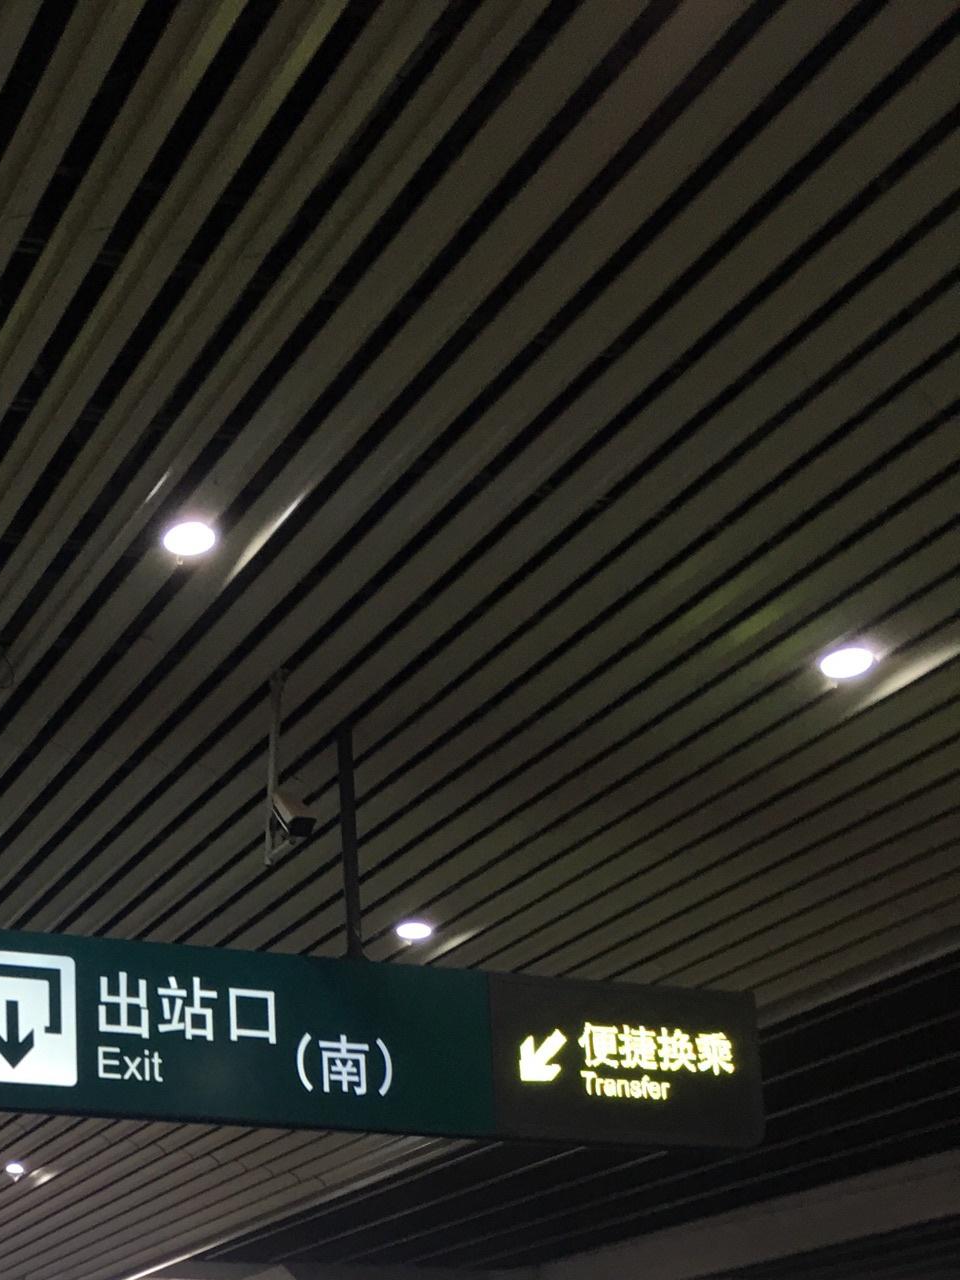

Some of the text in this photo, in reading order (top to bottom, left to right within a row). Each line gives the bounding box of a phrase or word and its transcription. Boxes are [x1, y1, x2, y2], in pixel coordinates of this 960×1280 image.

[97, 971, 278, 1045] 出站口
[97, 1045, 164, 1083] Exit
[577, 1021, 736, 1076] 便捷换乘
[579, 1070, 672, 1102] Transfer
